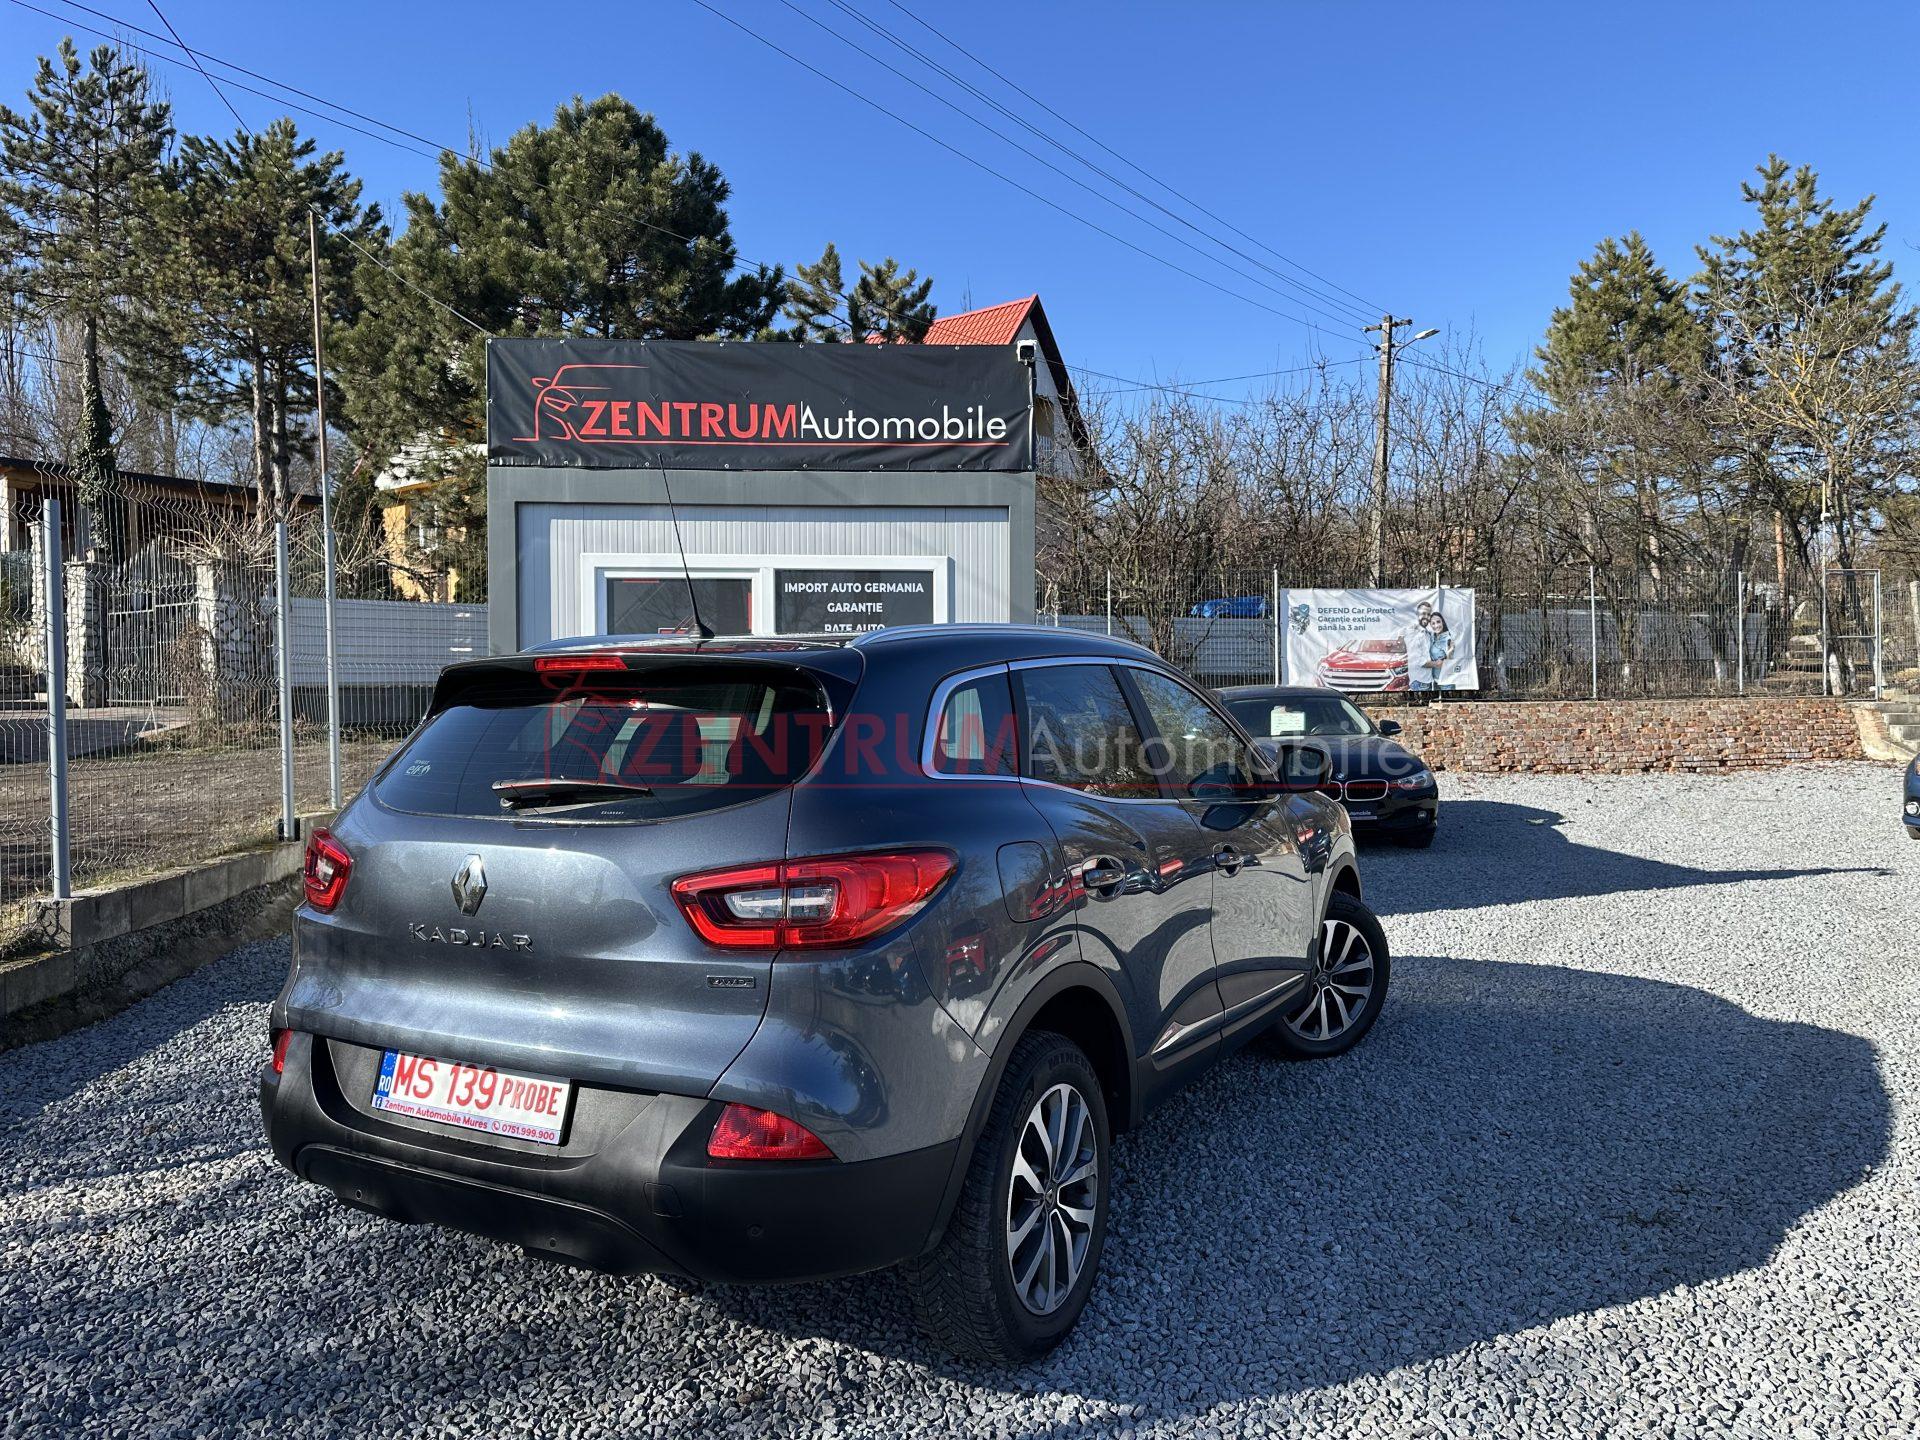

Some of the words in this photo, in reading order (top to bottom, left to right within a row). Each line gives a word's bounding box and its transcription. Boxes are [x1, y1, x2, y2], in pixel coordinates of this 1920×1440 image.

[580, 401, 797, 439] ZENTRUM
[801, 403, 1008, 441] Automobile
[784, 583, 829, 593] IMPORT
[830, 583, 862, 593] AUTO
[864, 583, 924, 593] GERMANIA
[408, 922, 535, 953] KADJAR
[378, 1075, 392, 1092] RO
[392, 1053, 439, 1099] MS
[446, 1061, 499, 1111] 139
[499, 1077, 563, 1117] PROBE
[384, 1099, 415, 1116] Zentrum
[415, 1107, 462, 1125] Automobile
[501, 1122, 556, 1142] 0751.999.900
